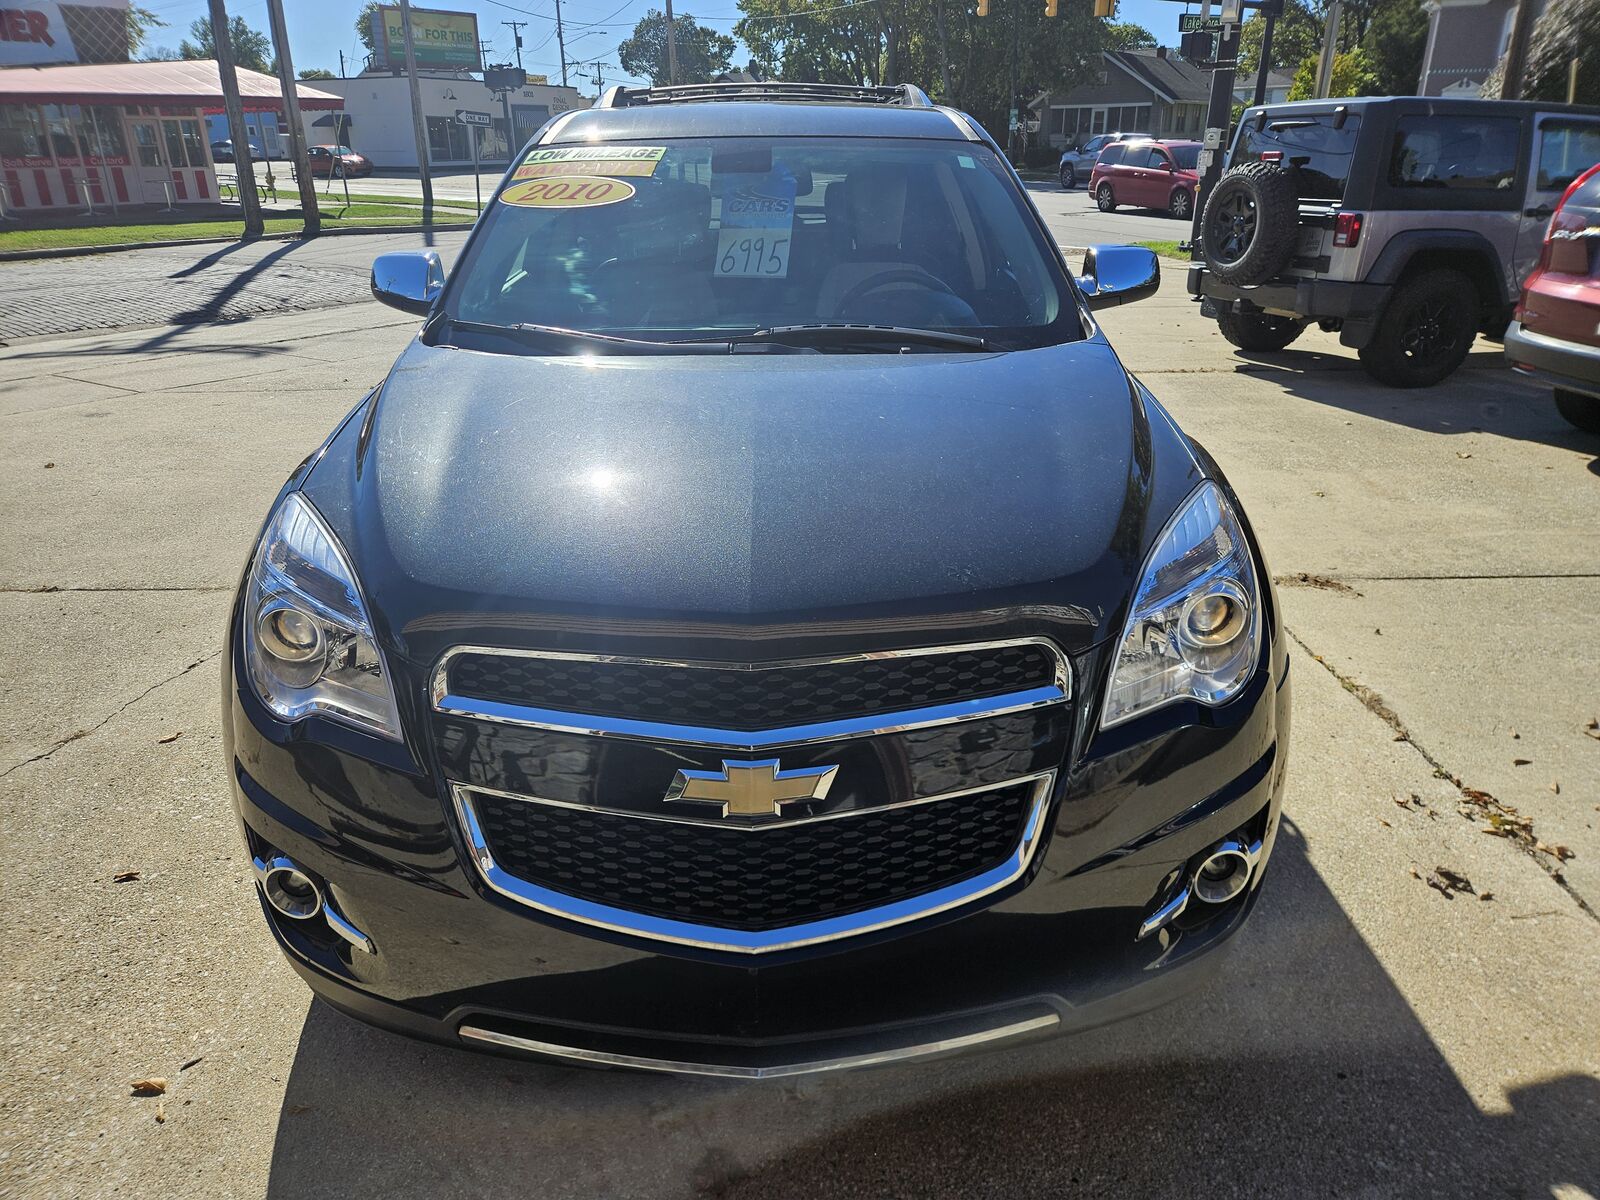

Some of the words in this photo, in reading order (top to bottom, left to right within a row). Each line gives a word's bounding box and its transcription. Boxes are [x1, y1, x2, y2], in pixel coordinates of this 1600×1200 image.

[425, 28, 447, 40] FOR
[449, 30, 473, 42] THIS
[526, 149, 572, 162] LOW
[572, 148, 664, 160] MILEAGE
[25, 157, 52, 168] Serve
[516, 183, 614, 201] 2010
[728, 199, 789, 212] CARS
[720, 238, 788, 274] 6995
